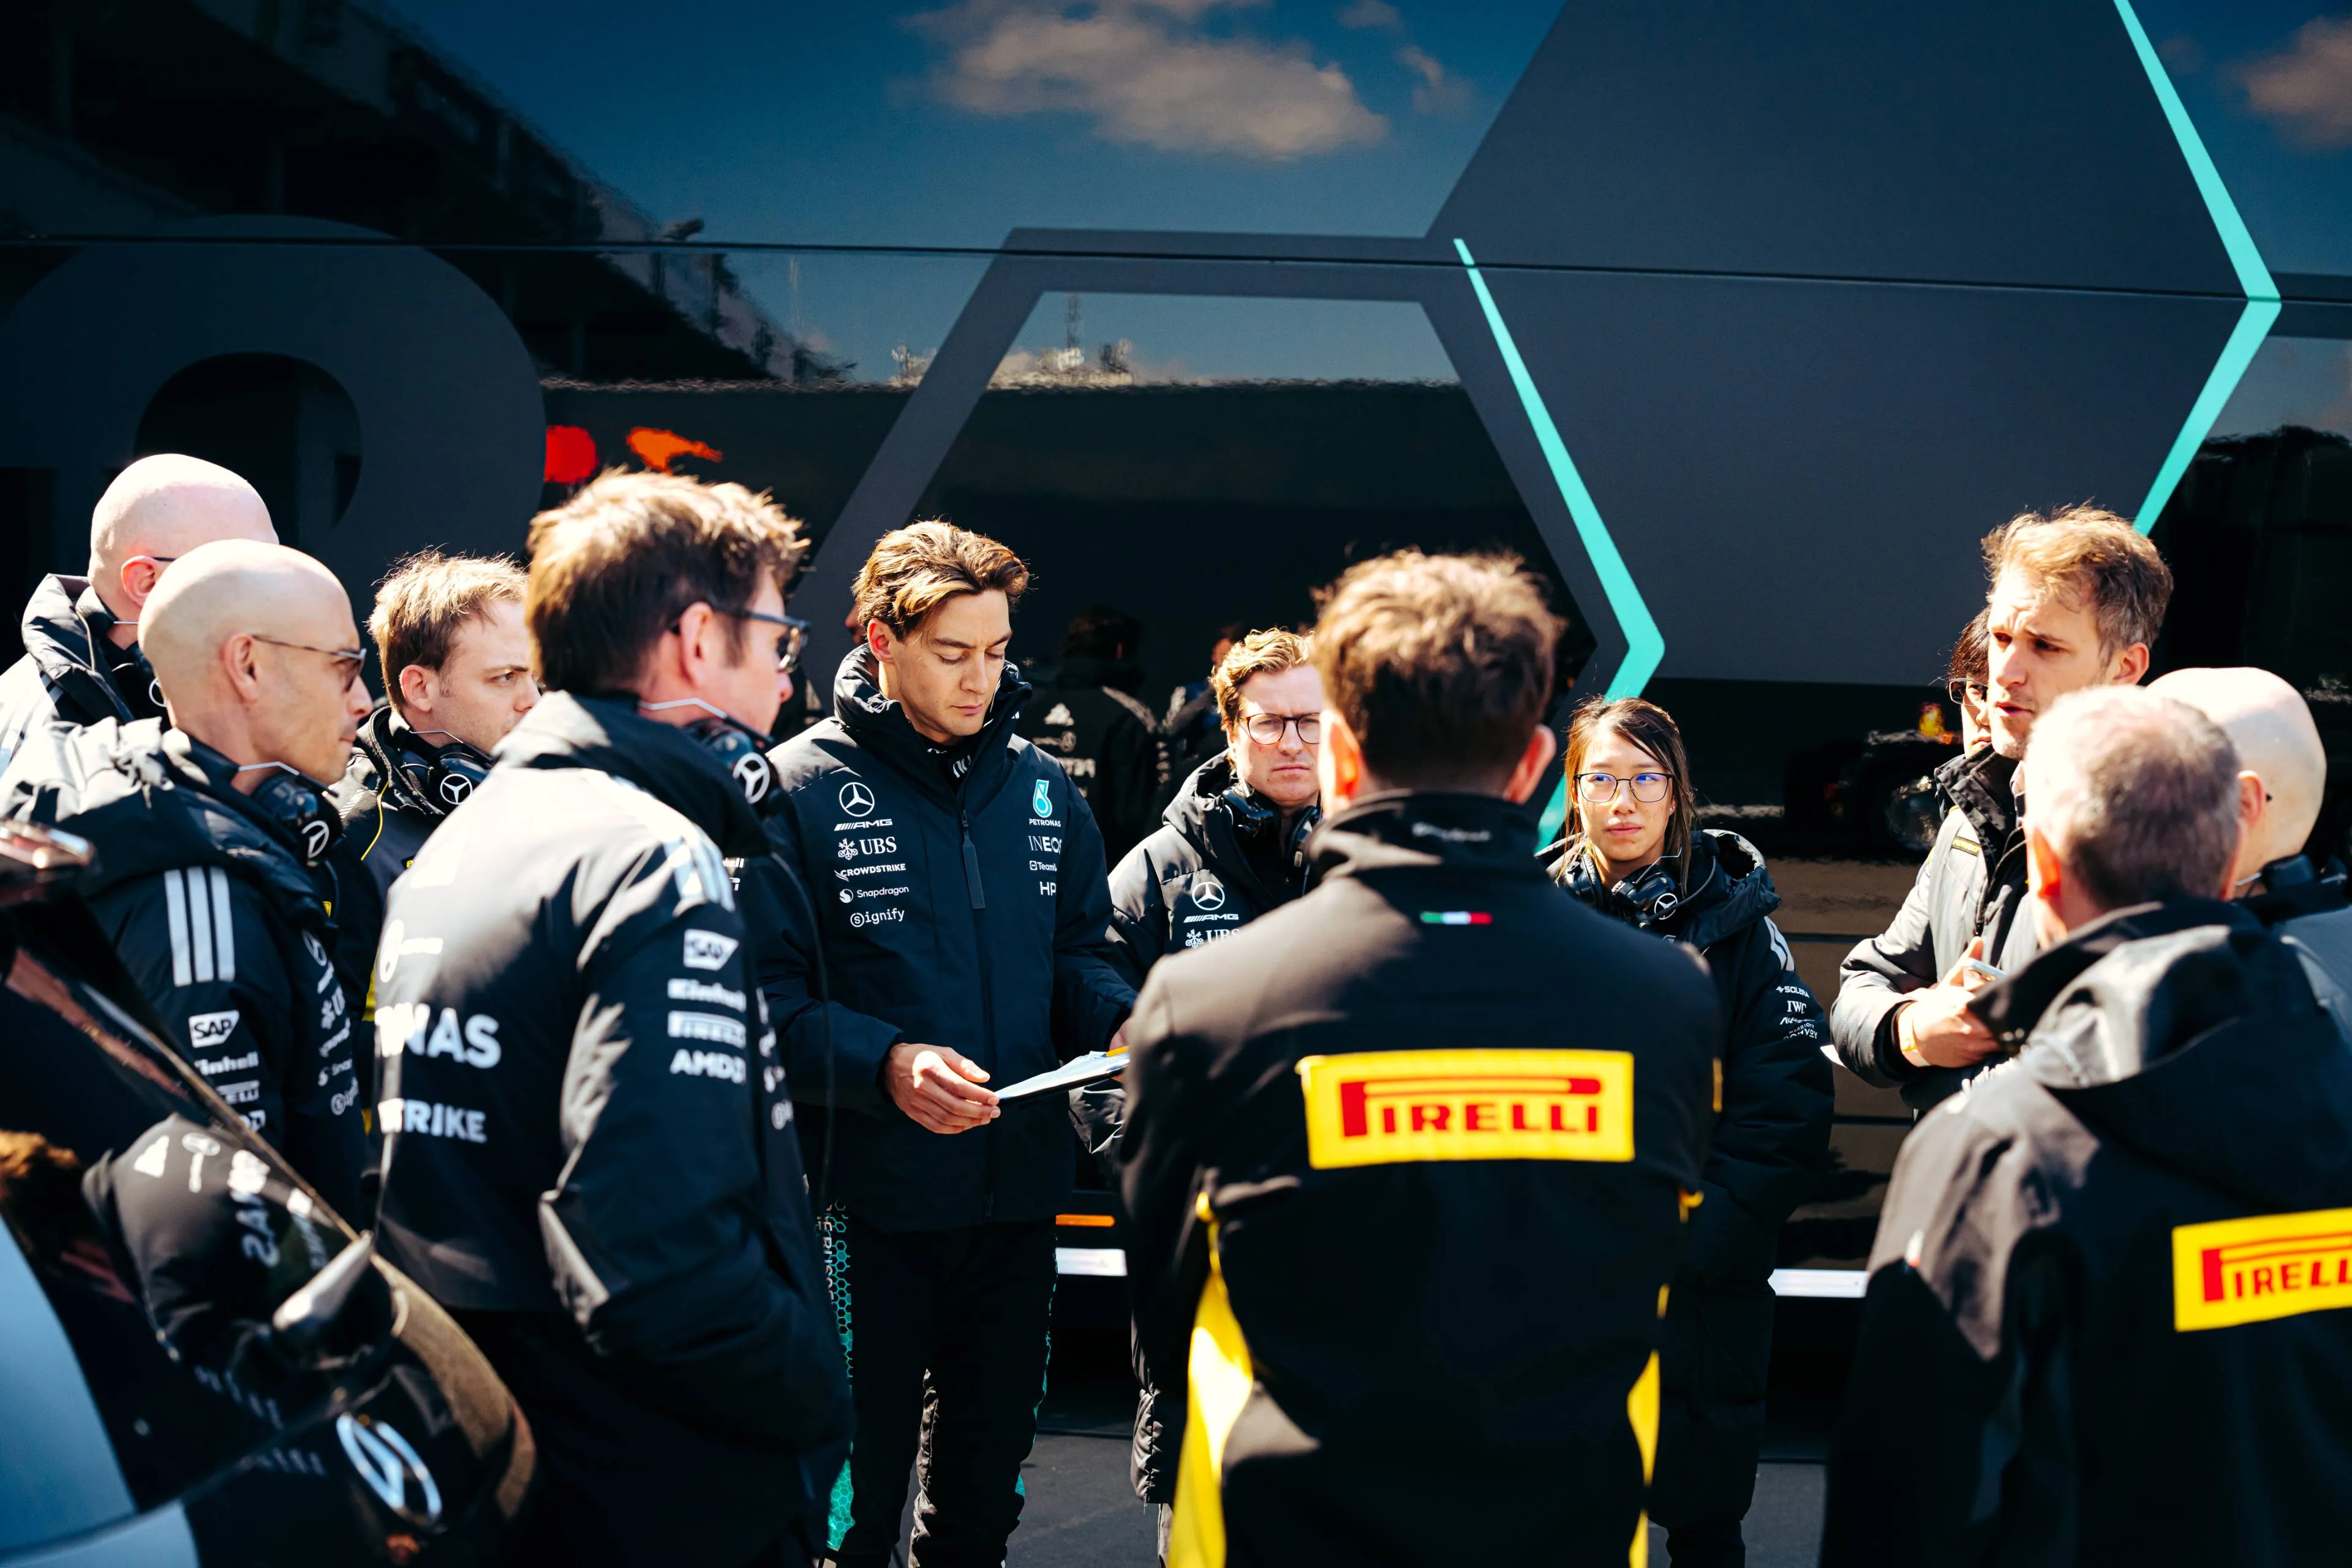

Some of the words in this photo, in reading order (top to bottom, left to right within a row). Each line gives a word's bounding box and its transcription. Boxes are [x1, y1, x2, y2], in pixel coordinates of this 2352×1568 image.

[852, 818, 893, 829] AMG
[1029, 818, 1061, 827] PETRONAS
[859, 836, 897, 855] UBS
[840, 863, 907, 876] CROWDSTRIKE
[856, 886, 910, 899] Snapdragon
[1784, 986, 1809, 998] SOLERA
[1787, 1000, 1807, 1014] IWC
[194, 1019, 232, 1040] SAP
[1340, 1076, 1602, 1138] PIRELLI
